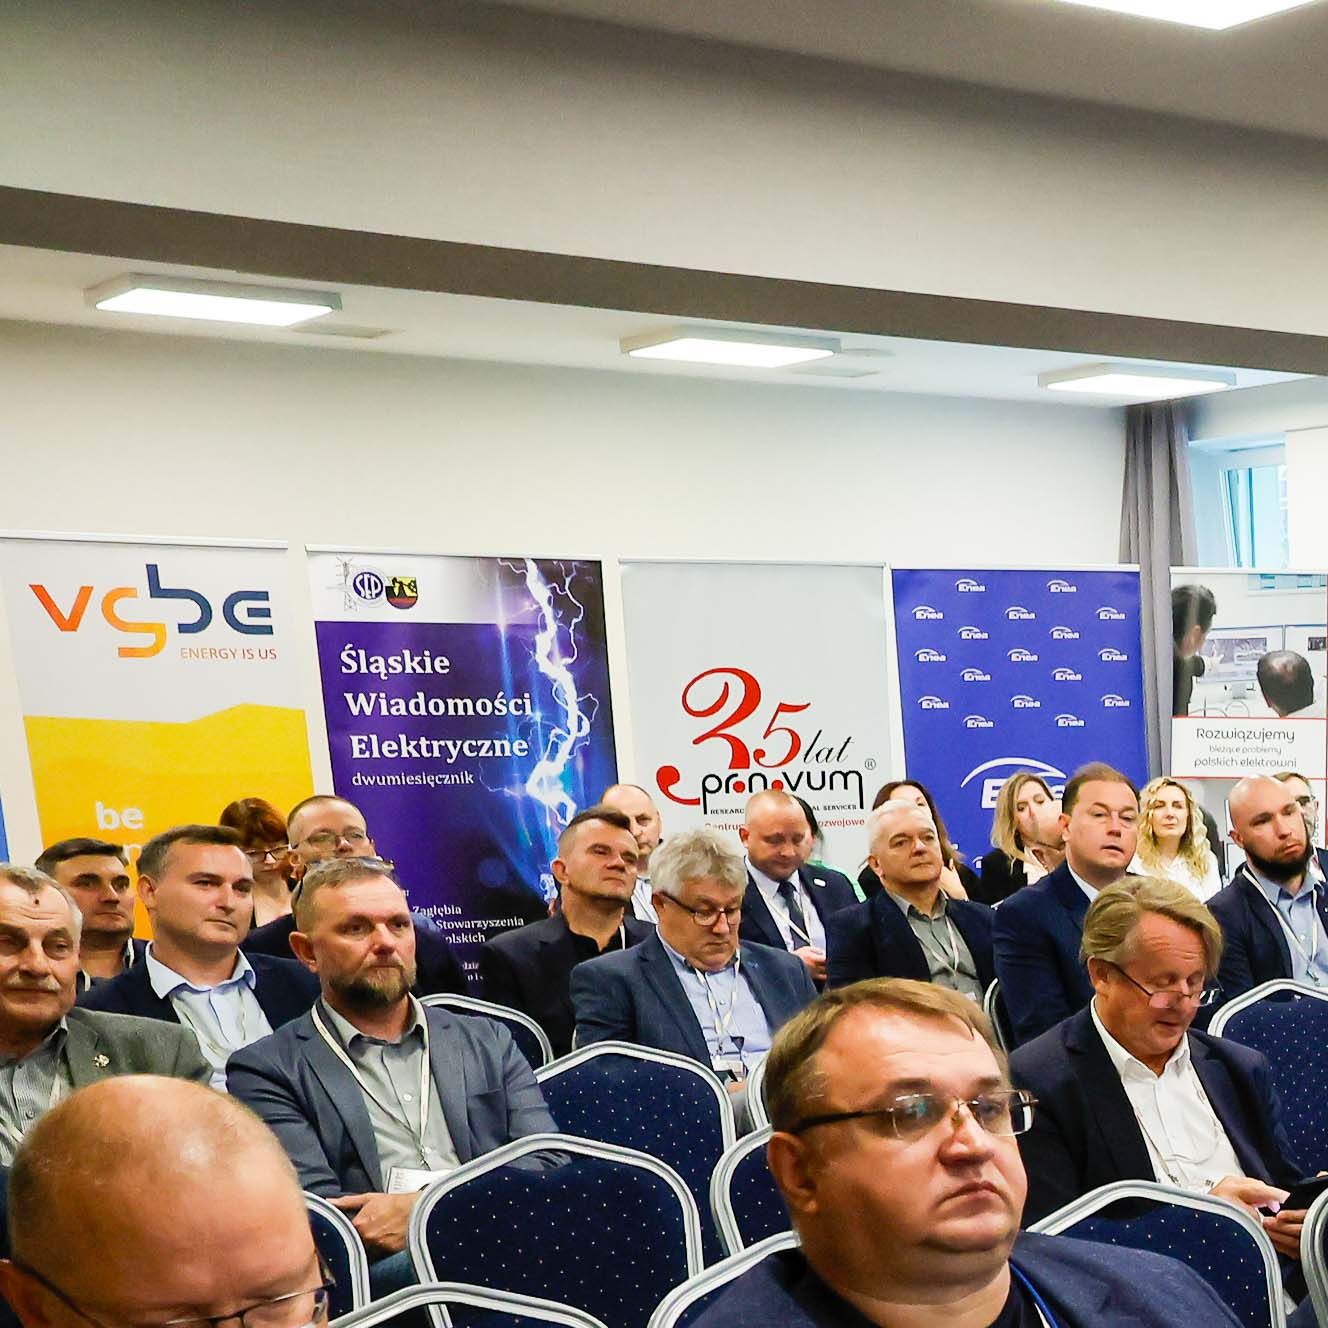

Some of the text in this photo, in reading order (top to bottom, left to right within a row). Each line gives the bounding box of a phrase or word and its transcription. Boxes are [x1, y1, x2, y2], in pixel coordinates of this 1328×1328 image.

[180, 648, 277, 659] ENERGY IS US
[340, 643, 450, 680] Śląskie
[344, 691, 532, 716] Wiadomości
[350, 734, 529, 764] Elektryczne
[804, 729, 855, 764] lat
[352, 771, 474, 788] dwumiesięcznik
[96, 801, 144, 830] be
[435, 916, 525, 930] Stowarzyszenia
